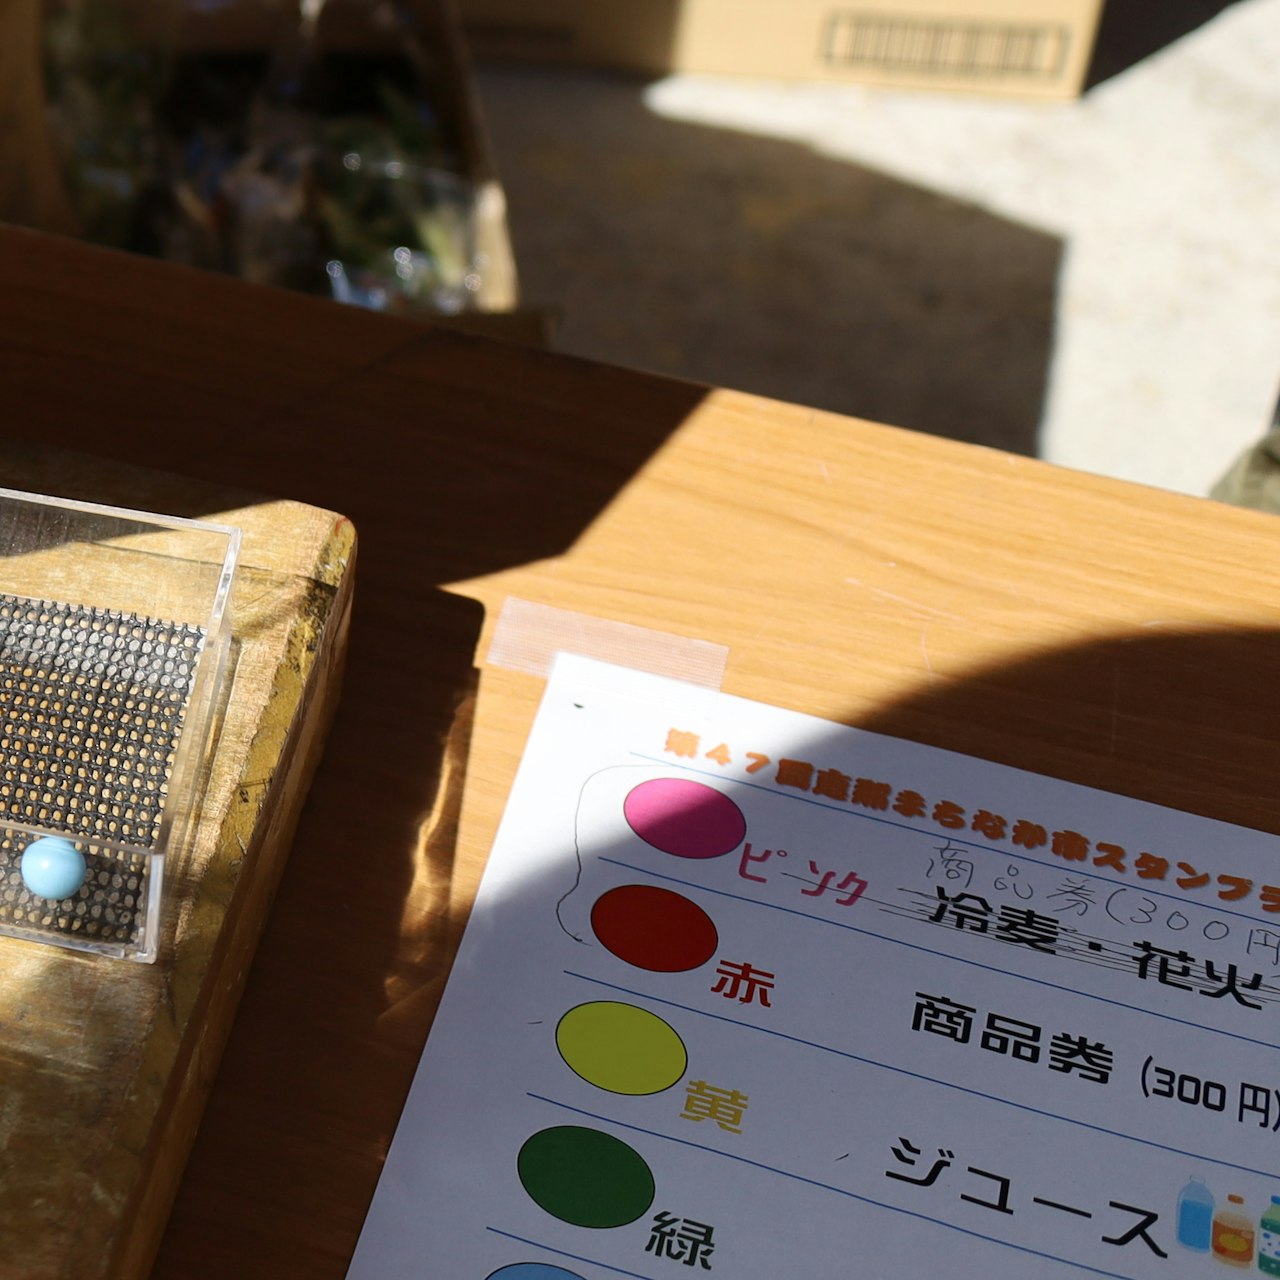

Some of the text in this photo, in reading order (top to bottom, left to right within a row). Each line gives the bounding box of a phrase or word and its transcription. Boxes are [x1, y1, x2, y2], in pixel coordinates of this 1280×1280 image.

[739, 843, 868, 907] ピンク
[711, 960, 775, 1008] 赤
[911, 992, 1114, 1085] 商品券
[679, 1080, 1168, 1259] 黄 ジュース
[645, 1211, 715, 1271] 緑
